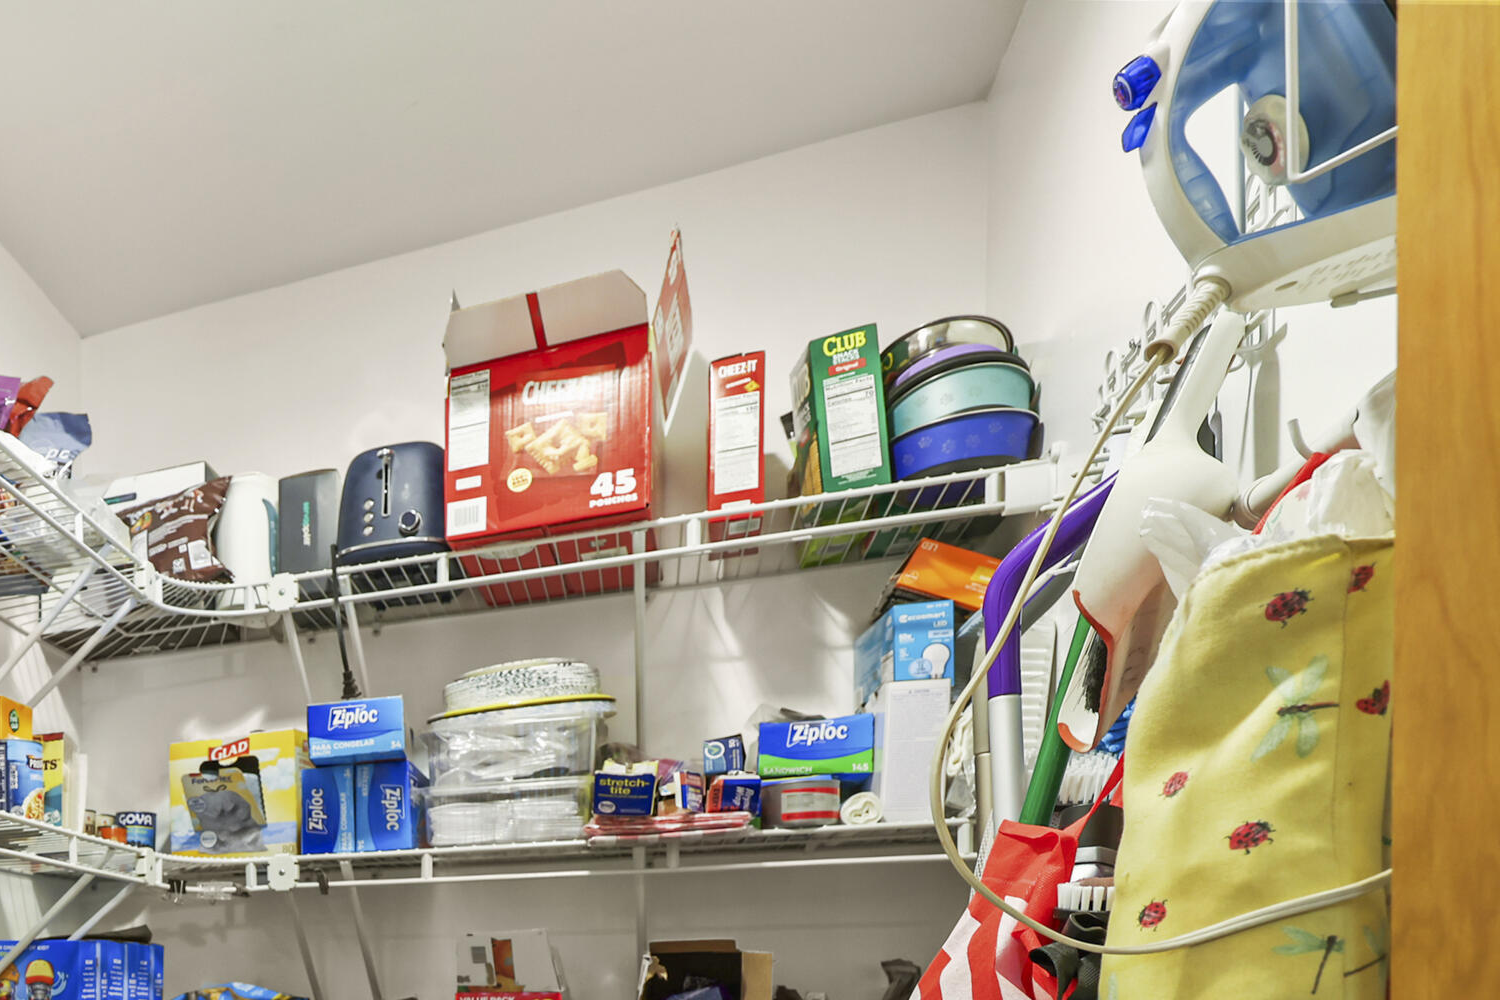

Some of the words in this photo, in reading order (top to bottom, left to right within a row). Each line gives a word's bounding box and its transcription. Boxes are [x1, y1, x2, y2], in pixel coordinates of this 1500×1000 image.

[822, 330, 867, 357] CLUB
[718, 359, 758, 378] CHEEZ-IT
[589, 468, 637, 498] 45
[331, 706, 379, 730] Ziploc
[790, 721, 848, 747] Ziploc
[210, 740, 249, 761] GLAD
[311, 744, 332, 752] PARA
[333, 738, 375, 751] CONGELAR
[763, 765, 813, 775] SANDWICH
[851, 761, 870, 772] 145
[598, 778, 651, 791] stretch-
[609, 786, 632, 796] tite
[307, 787, 328, 831] Ziploc
[381, 787, 400, 831] Ziploc
[117, 813, 153, 827] GOYA
